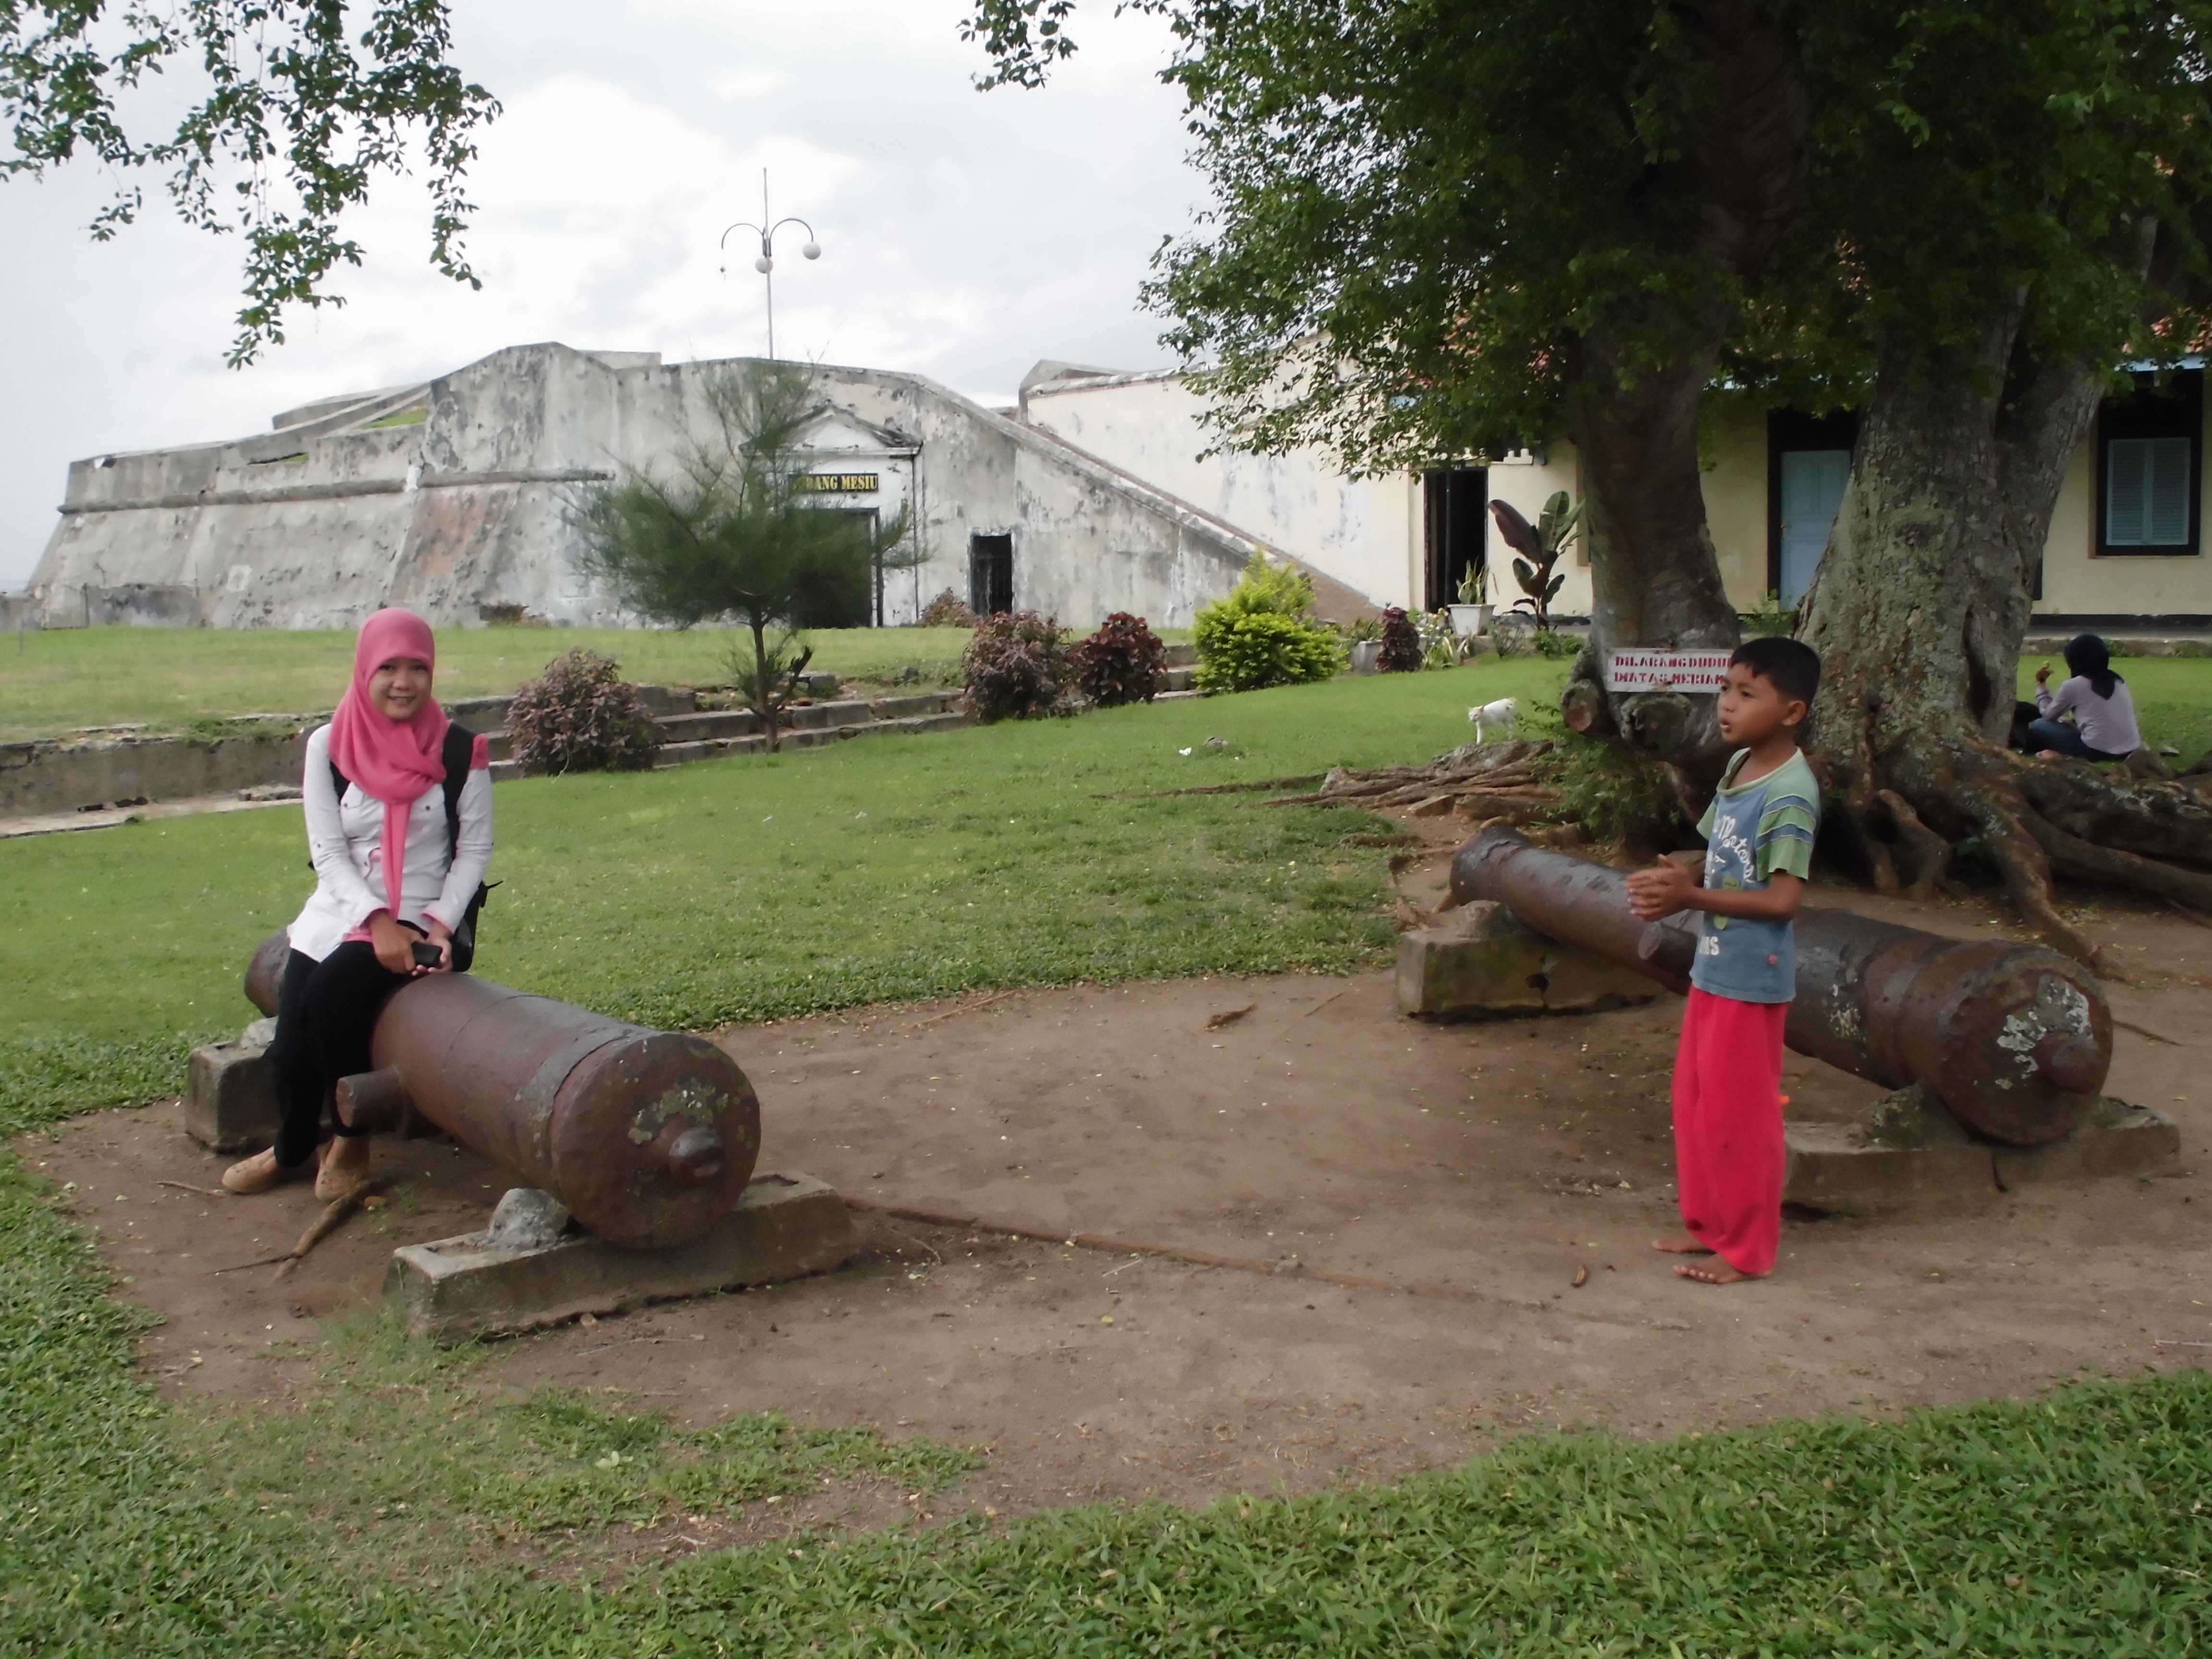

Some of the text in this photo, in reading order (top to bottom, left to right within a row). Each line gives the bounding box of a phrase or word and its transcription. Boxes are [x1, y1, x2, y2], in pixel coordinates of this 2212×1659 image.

[792, 475, 878, 490] DANG MESIU
[1616, 657, 1686, 667] DILARANG
[1614, 673, 1725, 684] DIATAS MERIAM
